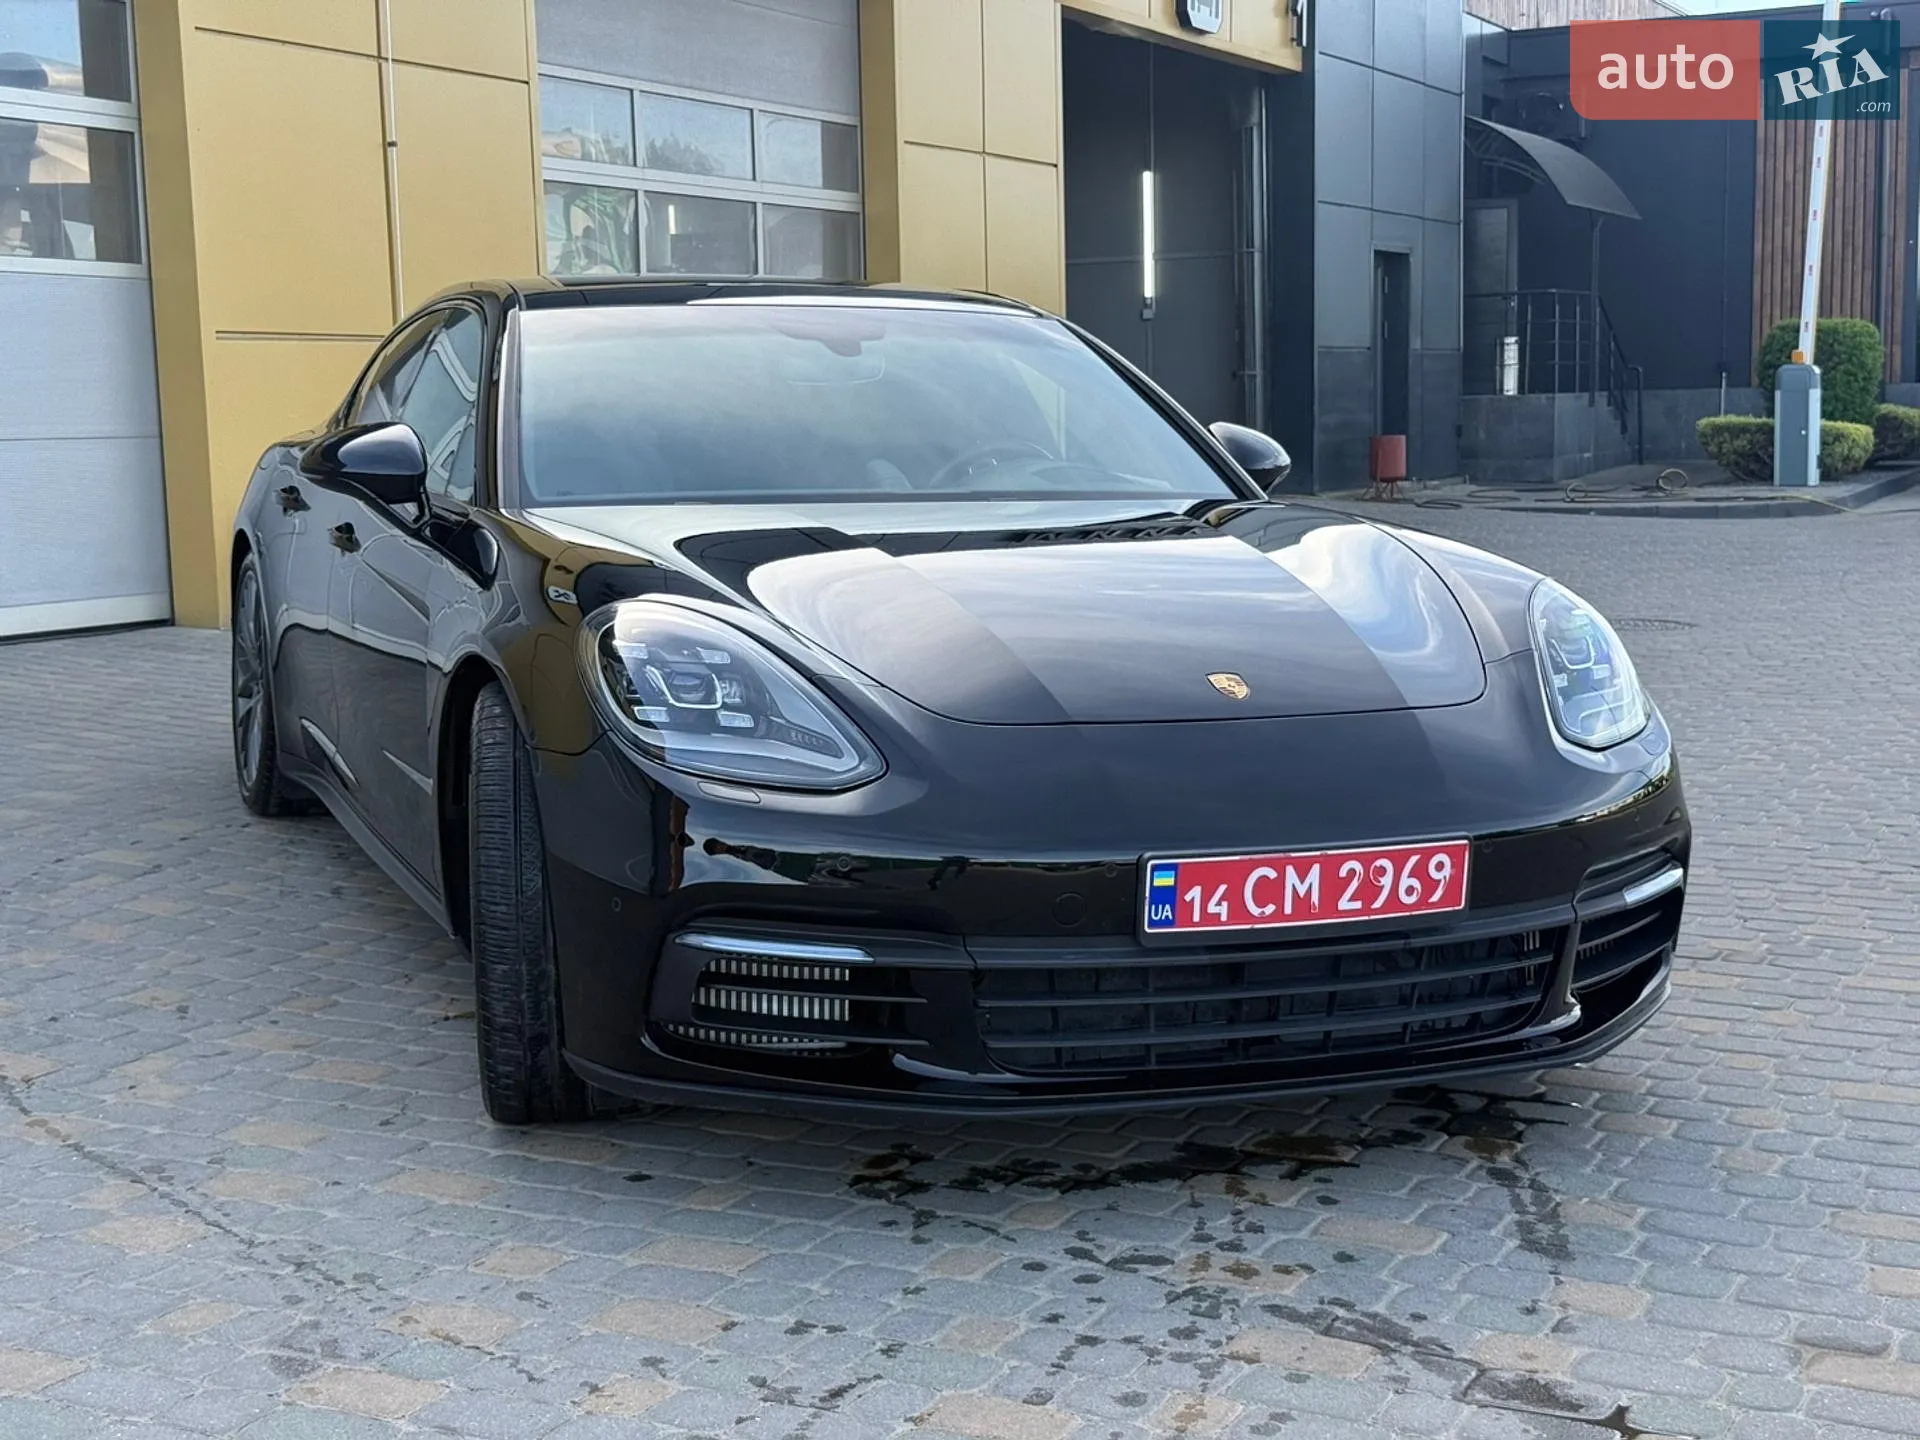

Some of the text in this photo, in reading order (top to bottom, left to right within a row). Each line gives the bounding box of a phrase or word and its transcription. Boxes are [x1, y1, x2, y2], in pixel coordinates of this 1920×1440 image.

[1183, 853, 1451, 922] 14 CM 2969
[1151, 904, 1173, 921] UA
